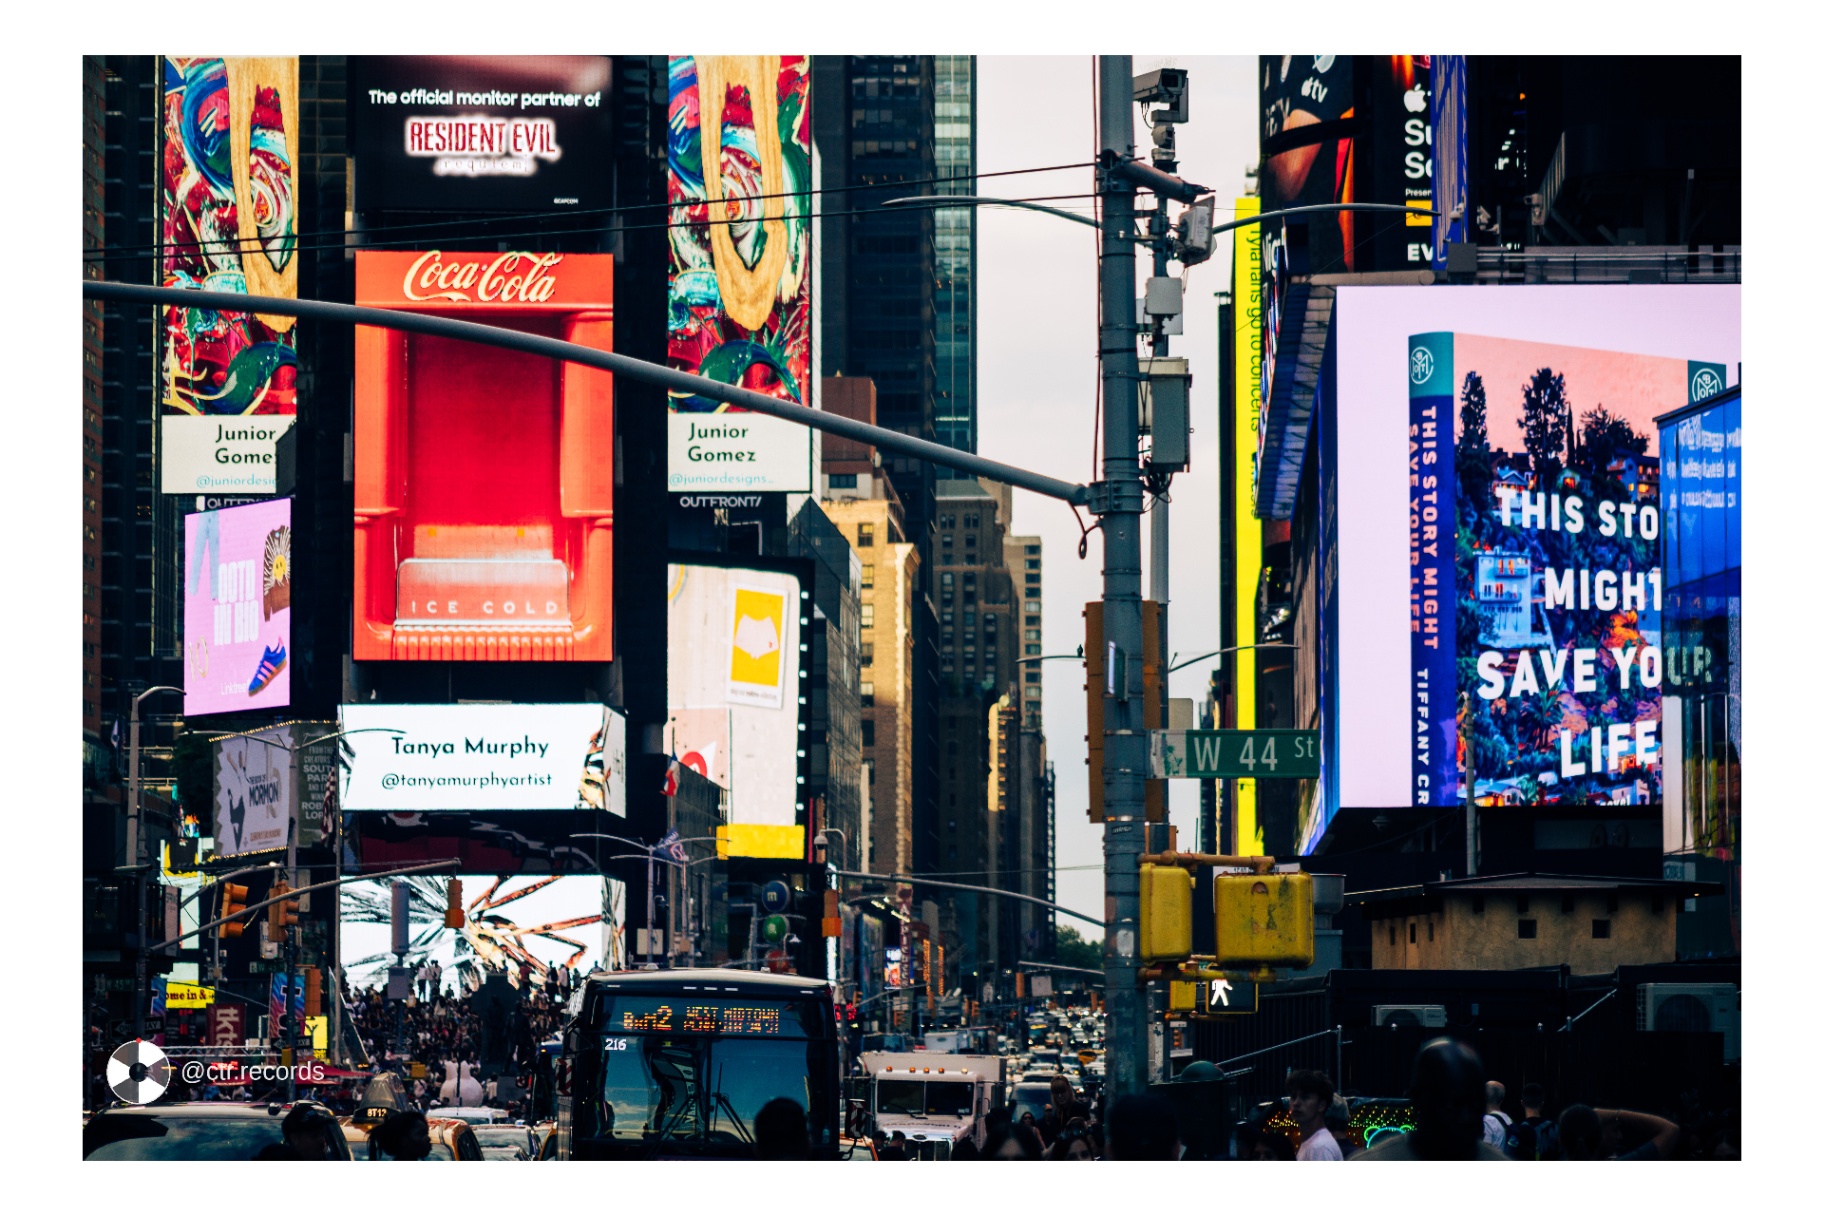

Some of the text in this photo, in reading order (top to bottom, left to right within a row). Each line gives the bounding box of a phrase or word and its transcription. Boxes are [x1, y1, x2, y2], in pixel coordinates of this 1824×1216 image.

[369, 89, 602, 109] The official monitor partner of
[409, 121, 557, 154] RESIDENT EVIL
[403, 249, 564, 303] Coca-Cola
[215, 424, 277, 443] Junior
[688, 422, 749, 441] Junior
[215, 448, 277, 464] Gome
[688, 446, 757, 462] Gomez
[1496, 486, 1584, 534] THIS
[1409, 423, 1420, 633] SAVE YOUR LIFE
[1422, 405, 1438, 649] THIS STORY MIGHT
[218, 558, 256, 604] OOTD
[411, 601, 559, 615] ICE COLD
[213, 600, 259, 646] IN BIO
[1476, 648, 1597, 700] SAVE
[391, 736, 550, 759] Tanya Murphy
[1417, 667, 1430, 805] TIFFANY CR
[1560, 719, 1658, 778] LIFE
[1194, 736, 1314, 772] W 44 St
[303, 764, 332, 773] SOUT
[307, 774, 328, 782] PAR
[381, 771, 552, 791] @tanyamurphyartist
[249, 780, 279, 807] MORMON
[165, 991, 184, 1000] ome
[604, 1037, 627, 1051] 216
